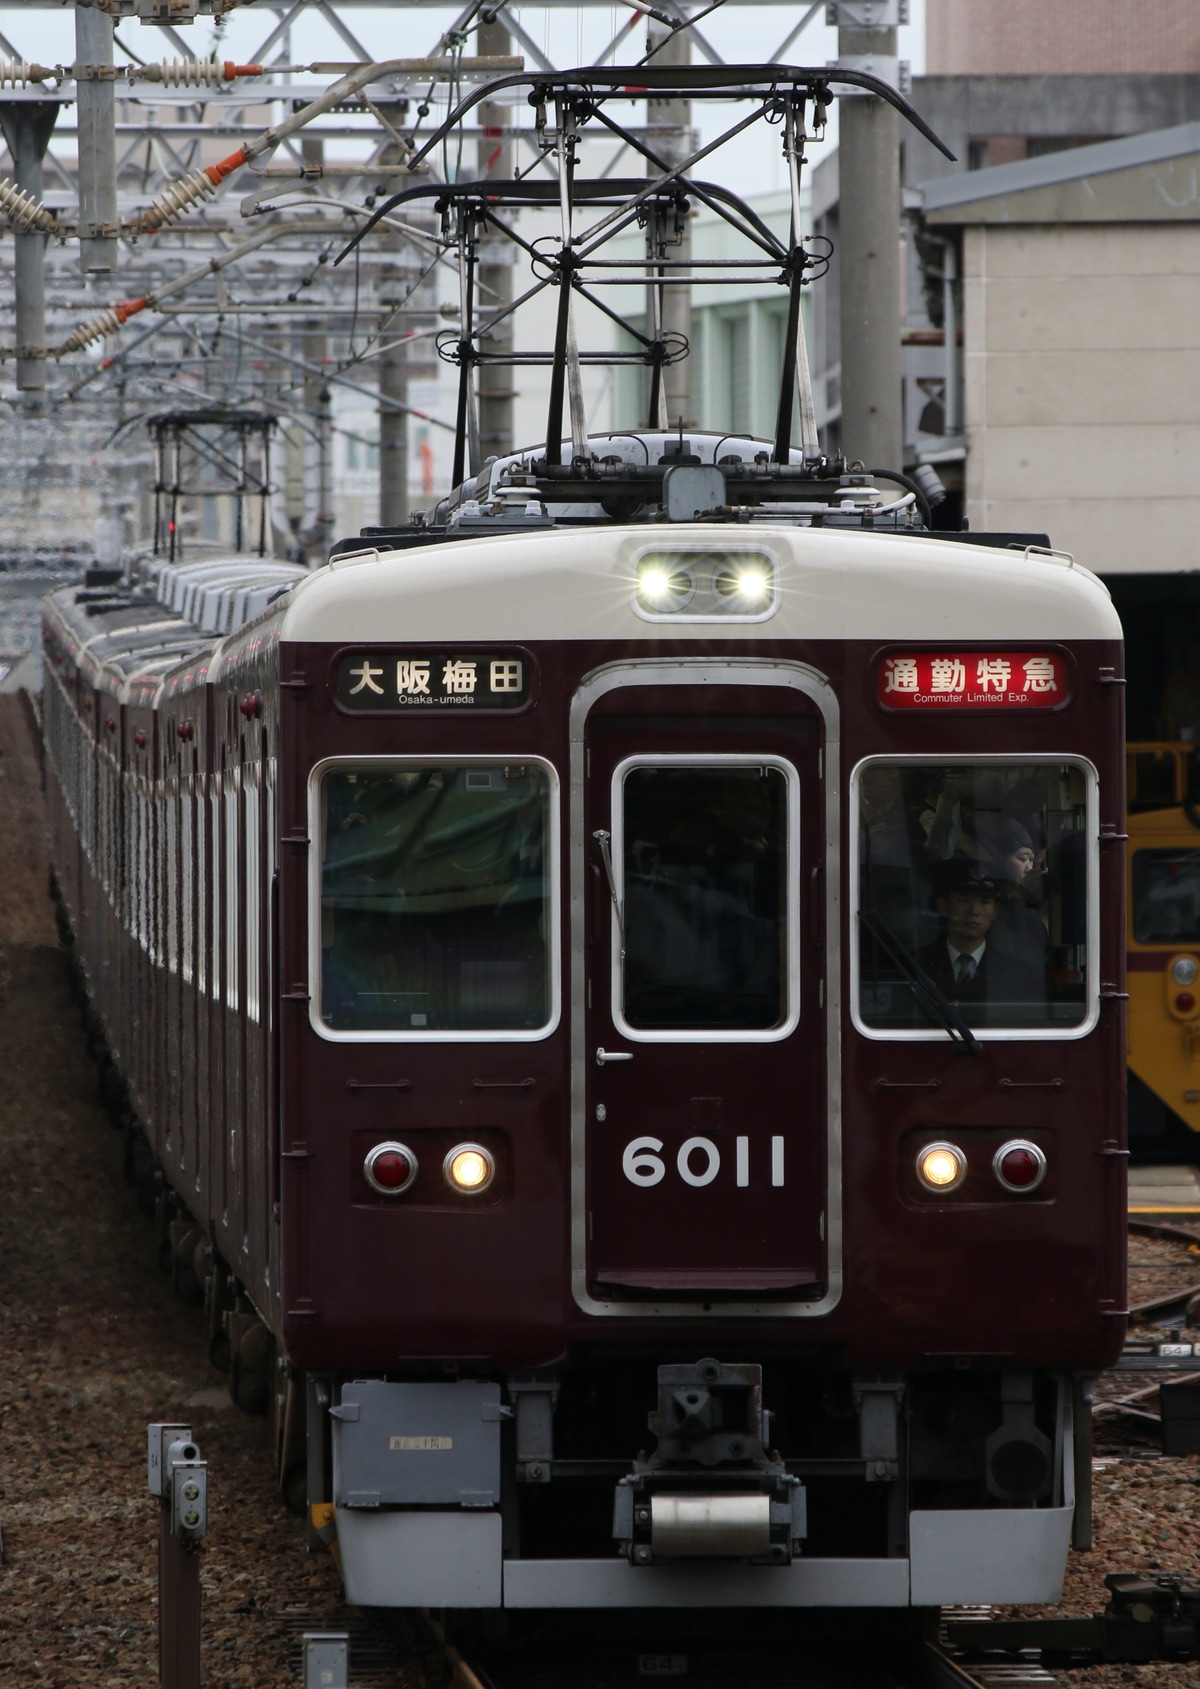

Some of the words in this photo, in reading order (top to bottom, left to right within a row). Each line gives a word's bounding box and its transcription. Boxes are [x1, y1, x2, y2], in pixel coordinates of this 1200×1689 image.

[349, 660, 523, 695] 大阪梅田
[884, 657, 1058, 693] 通勤特急
[398, 694, 475, 704] Osaka-umeda
[913, 693, 963, 703] Commuter
[967, 692, 1004, 702] Limited
[1008, 692, 1030, 702] Exp.
[622, 1135, 785, 1188] 6011
